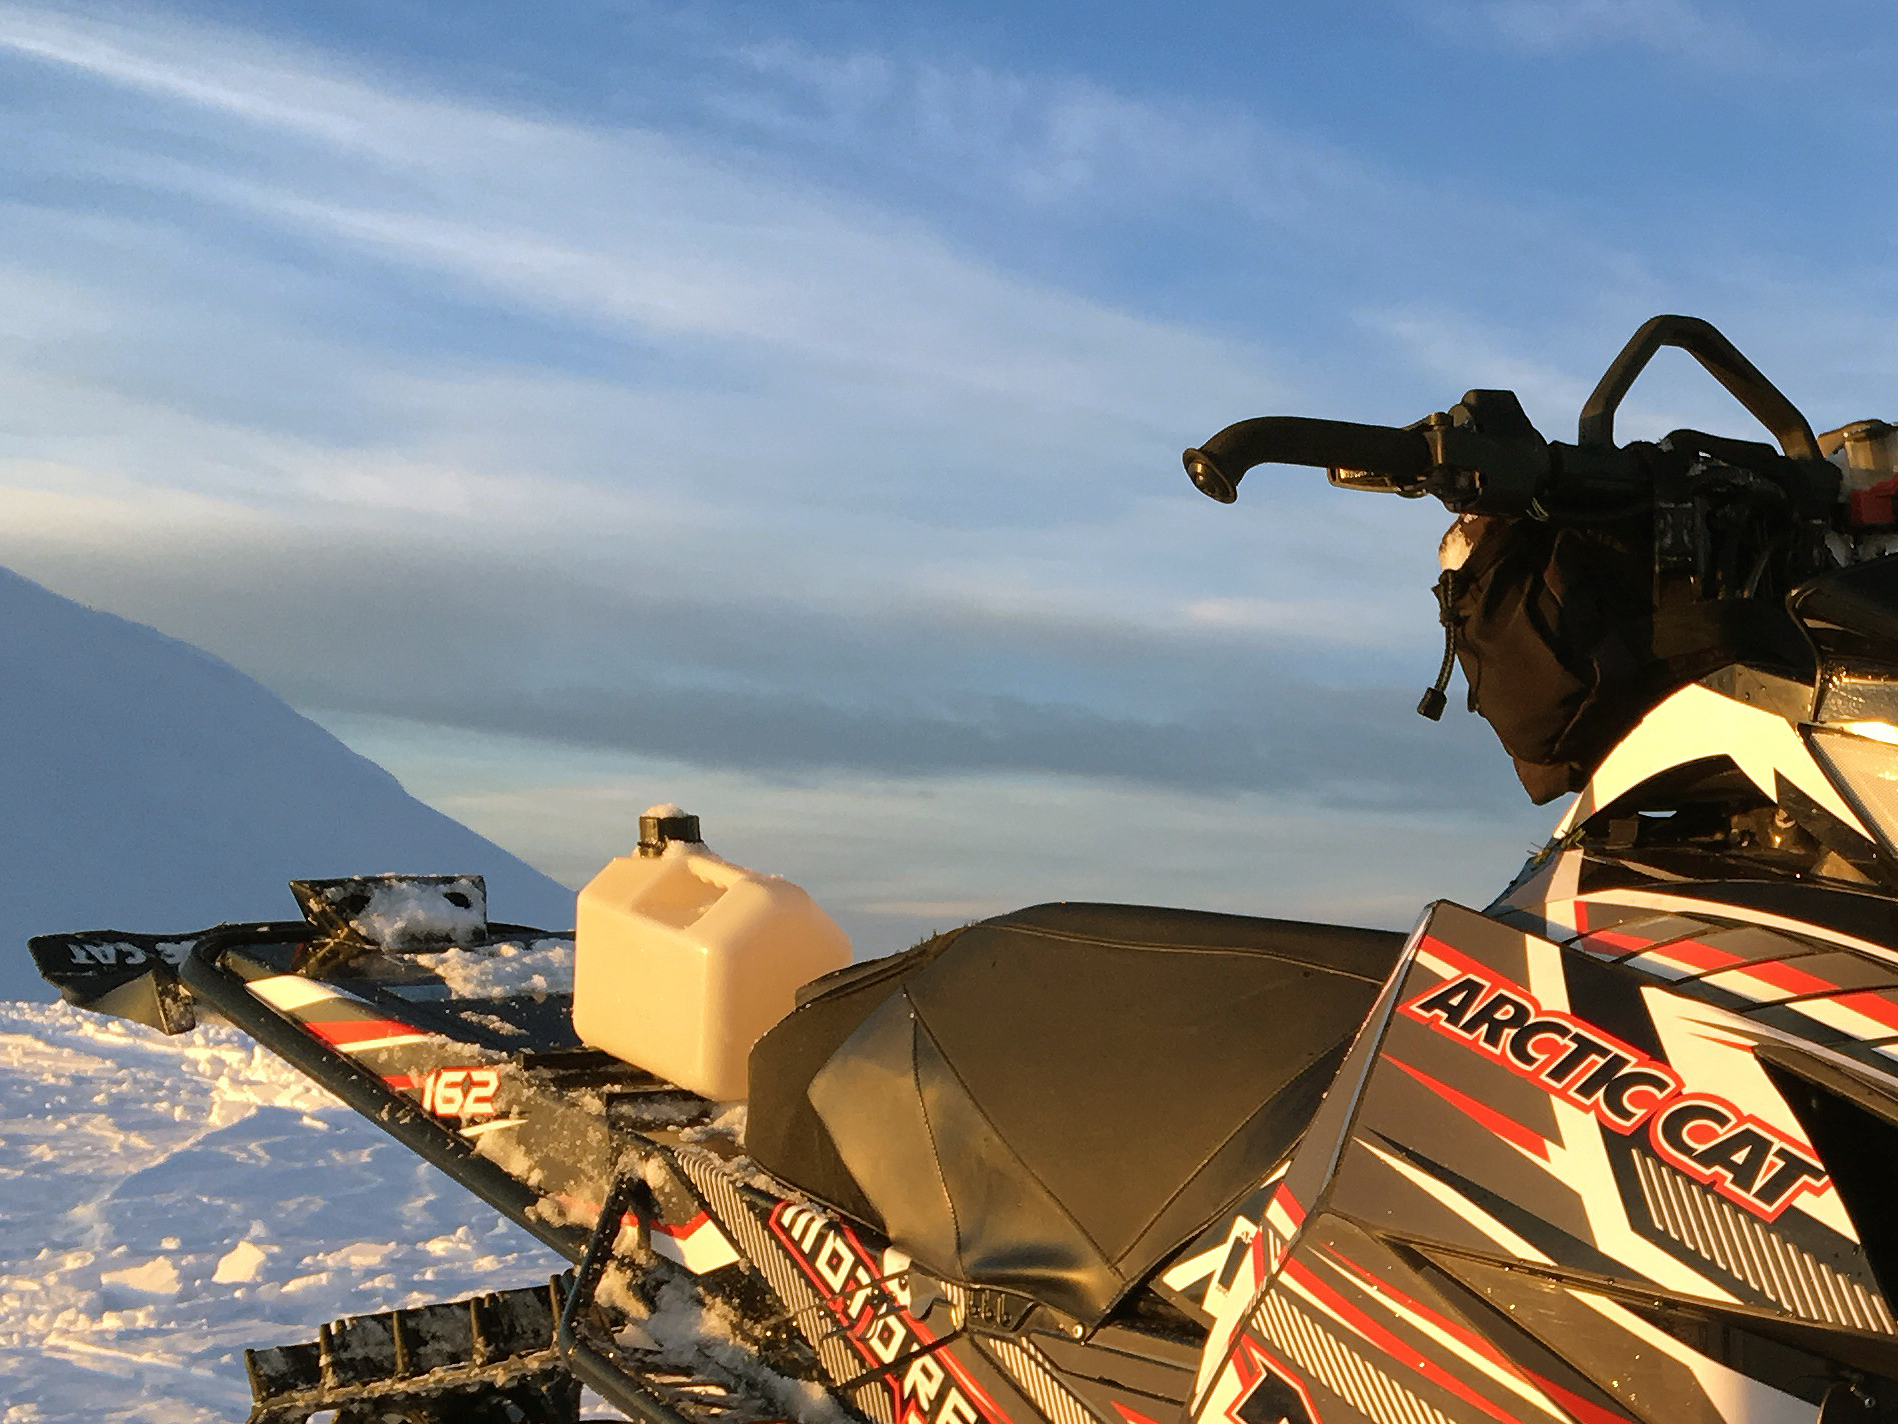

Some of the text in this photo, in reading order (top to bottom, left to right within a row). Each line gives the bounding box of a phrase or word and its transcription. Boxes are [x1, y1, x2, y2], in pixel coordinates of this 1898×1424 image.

[421, 1069, 500, 1115] 162
[1411, 974, 1829, 1214] ARCTIC CAT
